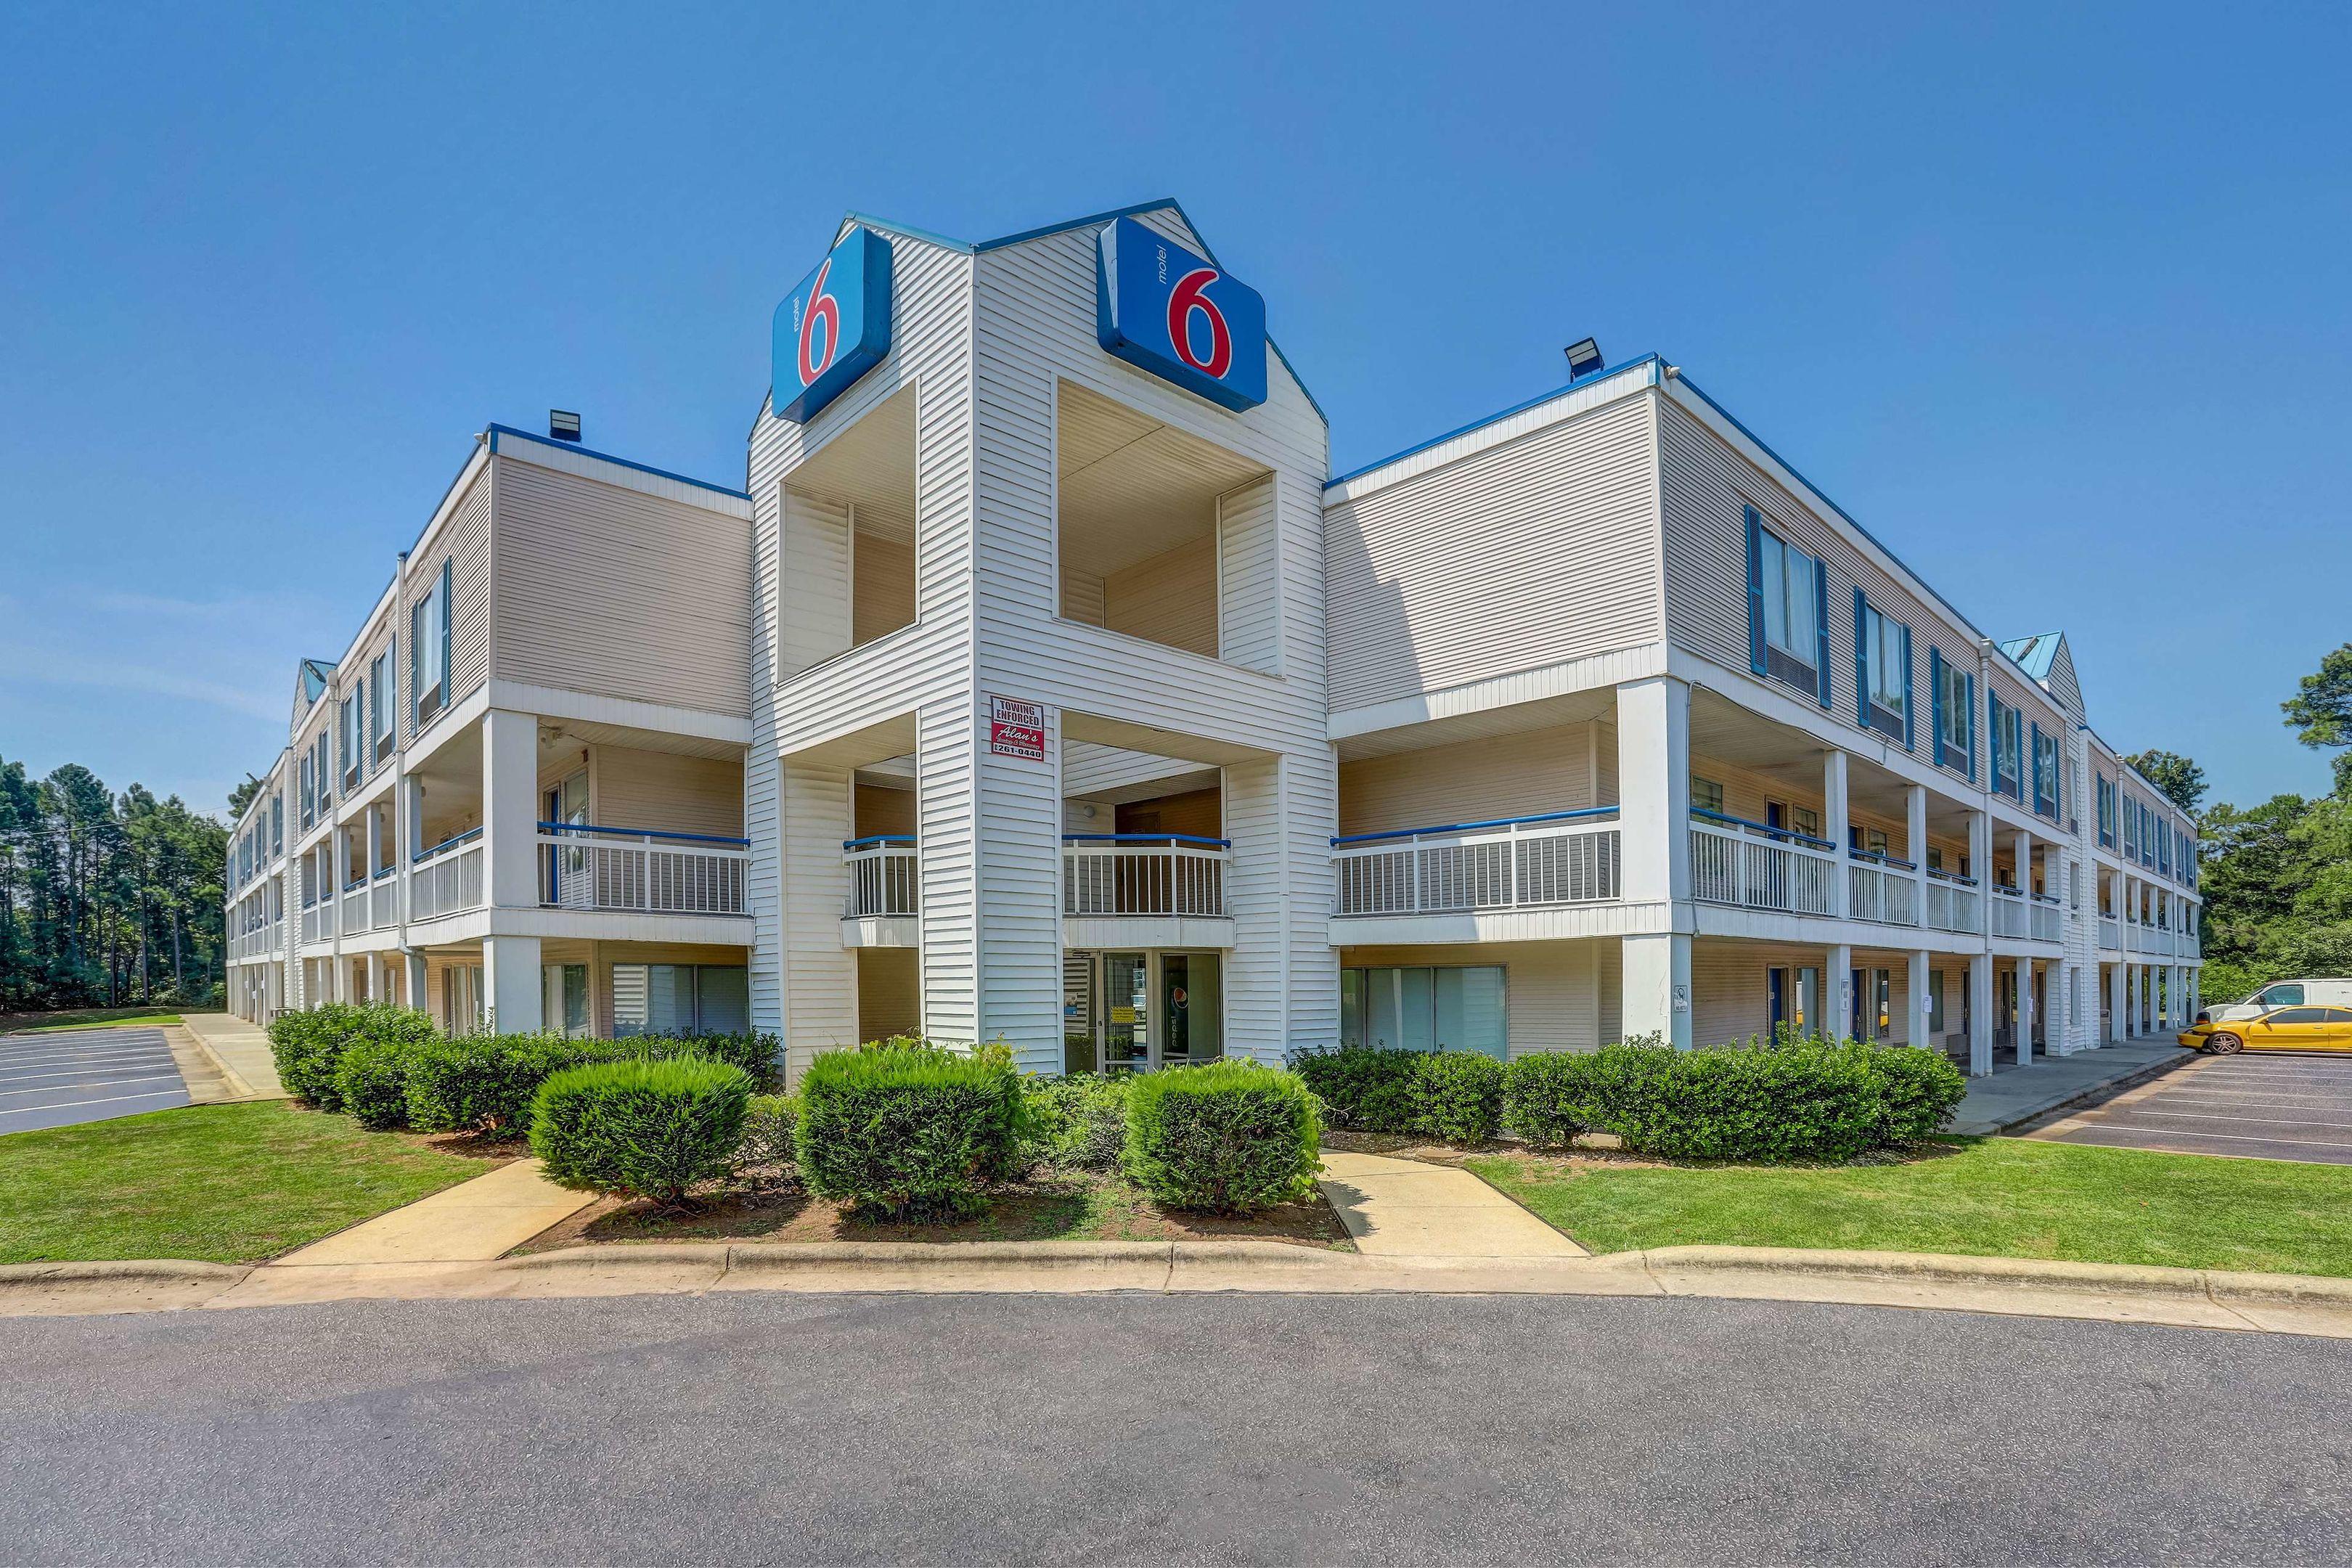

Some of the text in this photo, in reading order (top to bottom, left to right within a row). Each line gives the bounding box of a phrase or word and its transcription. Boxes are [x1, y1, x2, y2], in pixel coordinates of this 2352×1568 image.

[1156, 245, 1167, 284] motel
[799, 257, 839, 387] 6
[1167, 267, 1232, 380] 6
[1000, 701, 1034, 715] TOWING
[996, 709, 1040, 726] ENFORCED
[997, 726, 1039, 742] Alan's
[998, 745, 1041, 758] 261-0440
